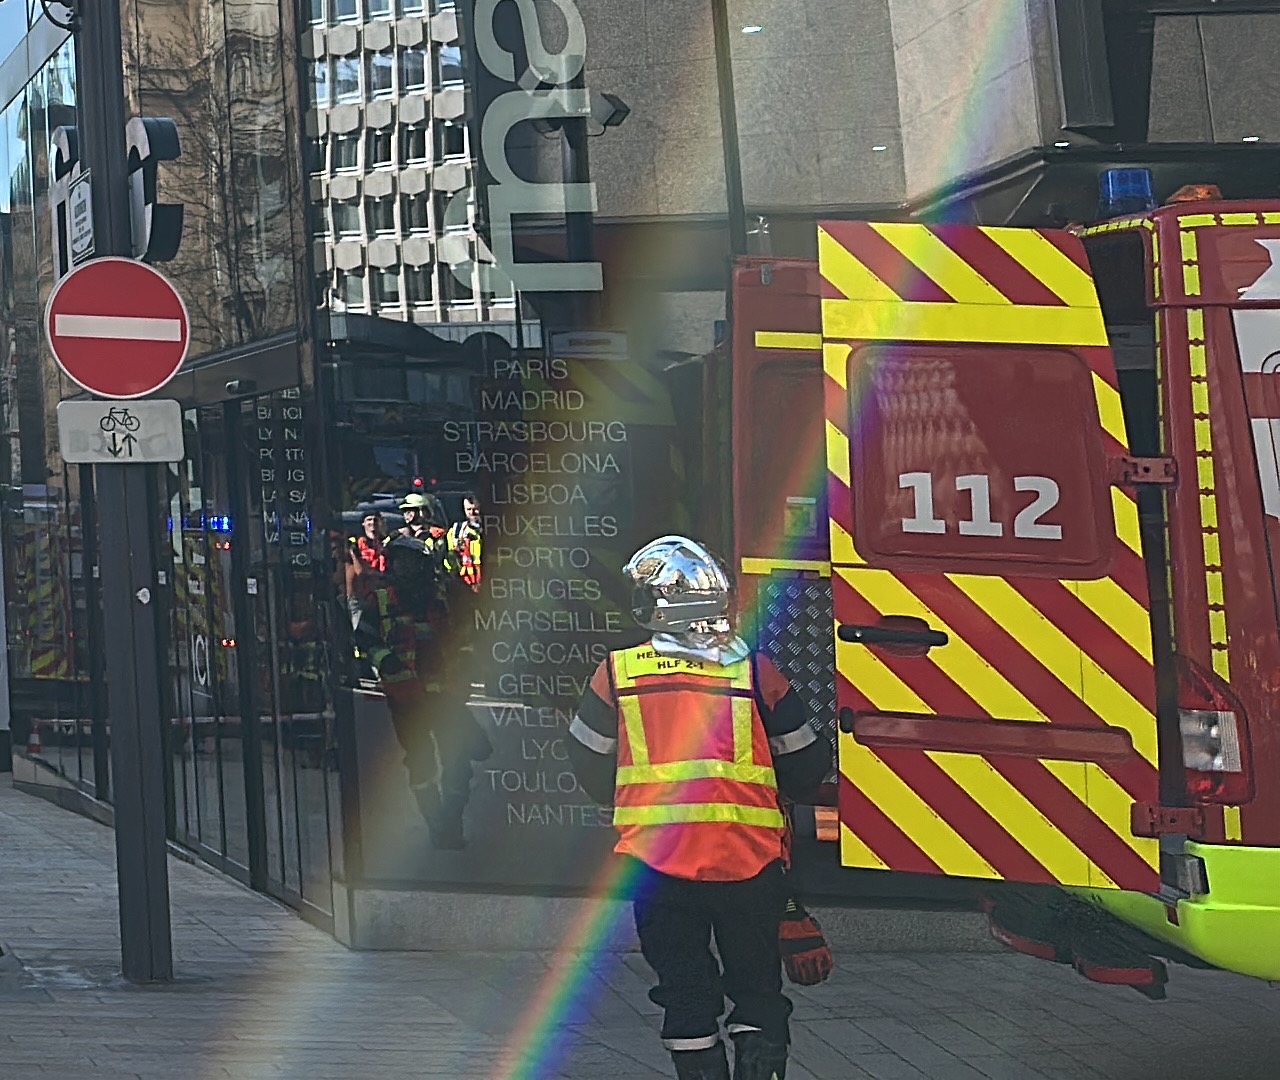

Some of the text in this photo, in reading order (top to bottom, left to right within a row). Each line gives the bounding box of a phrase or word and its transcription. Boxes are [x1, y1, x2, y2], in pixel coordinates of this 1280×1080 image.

[493, 359, 568, 380] PARIS
[481, 390, 584, 410] MADRID
[443, 421, 627, 442] STRASBOURG
[456, 452, 620, 473] BARCELONA
[492, 484, 588, 504] LISBOA
[898, 472, 1062, 540] 112
[480, 515, 617, 537] RUXELLES
[497, 546, 590, 568] PORTO
[490, 578, 601, 600] BRUGES
[474, 609, 622, 632] MARSEILLE
[492, 641, 607, 664] CASCAIS
[657, 659, 681, 670] HLF
[498, 671, 590, 696] GENÈV
[490, 706, 573, 728] VALEN
[486, 770, 577, 793] TOULO
[507, 803, 613, 826] NANTES
